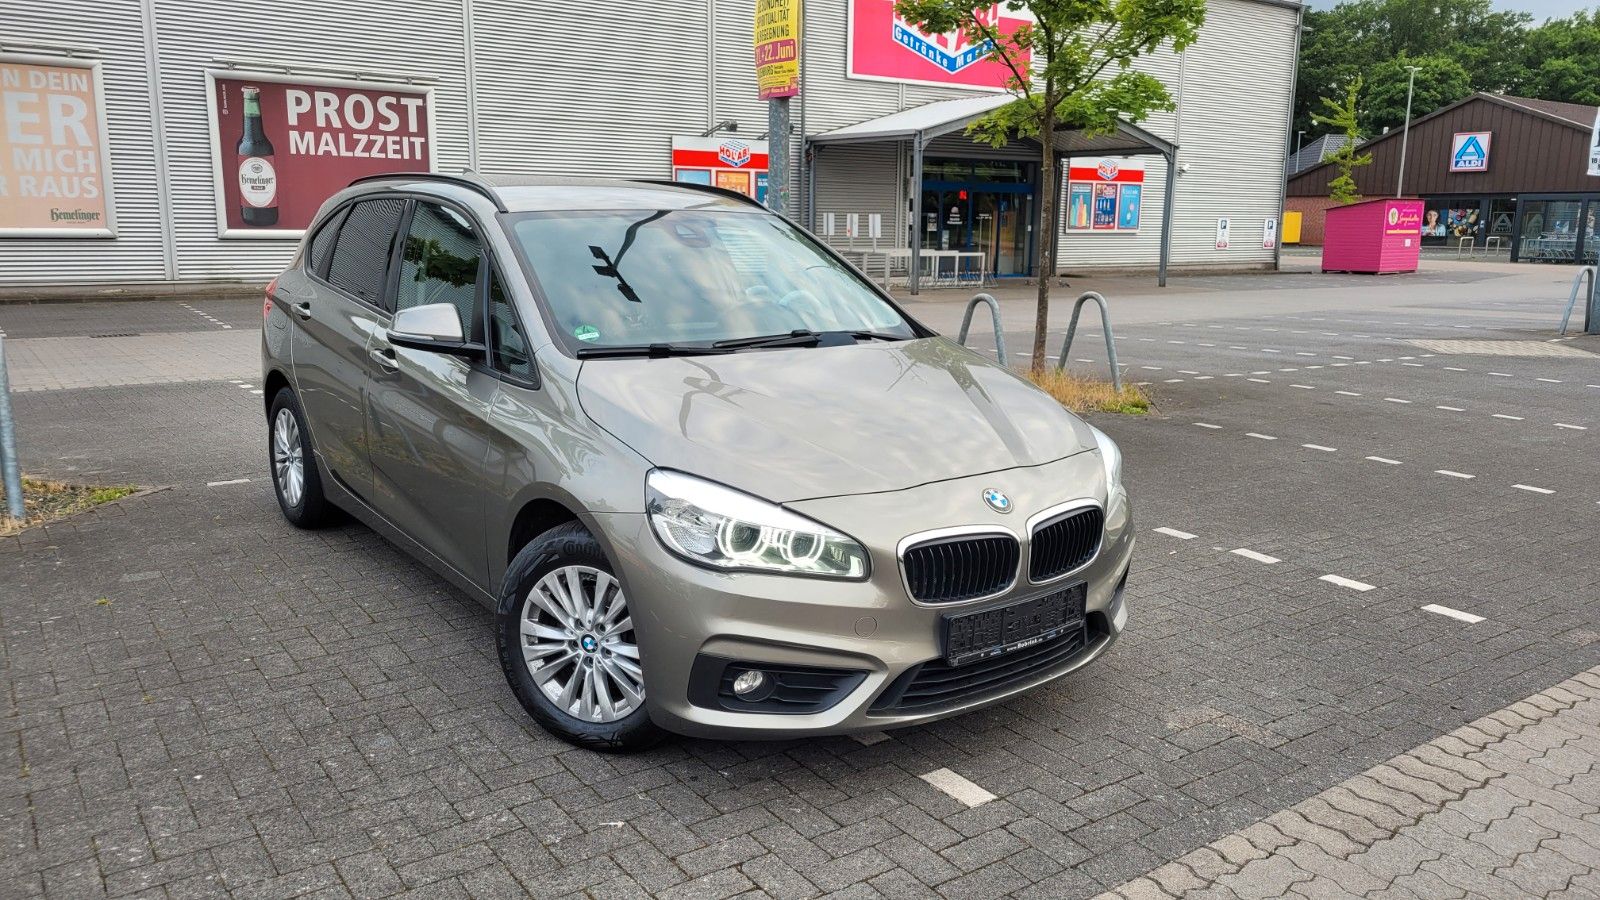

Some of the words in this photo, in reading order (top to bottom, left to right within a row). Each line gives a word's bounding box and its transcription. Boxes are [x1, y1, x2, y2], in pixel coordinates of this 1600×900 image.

[776, 40, 794, 60] Juni
[895, 26, 948, 68] Getränke
[28, 70, 88, 92] DEIN
[285, 89, 424, 133] PROST
[288, 130, 426, 160] MALZZEIT
[12, 148, 97, 173] MICH
[19, 175, 99, 199] RAUS
